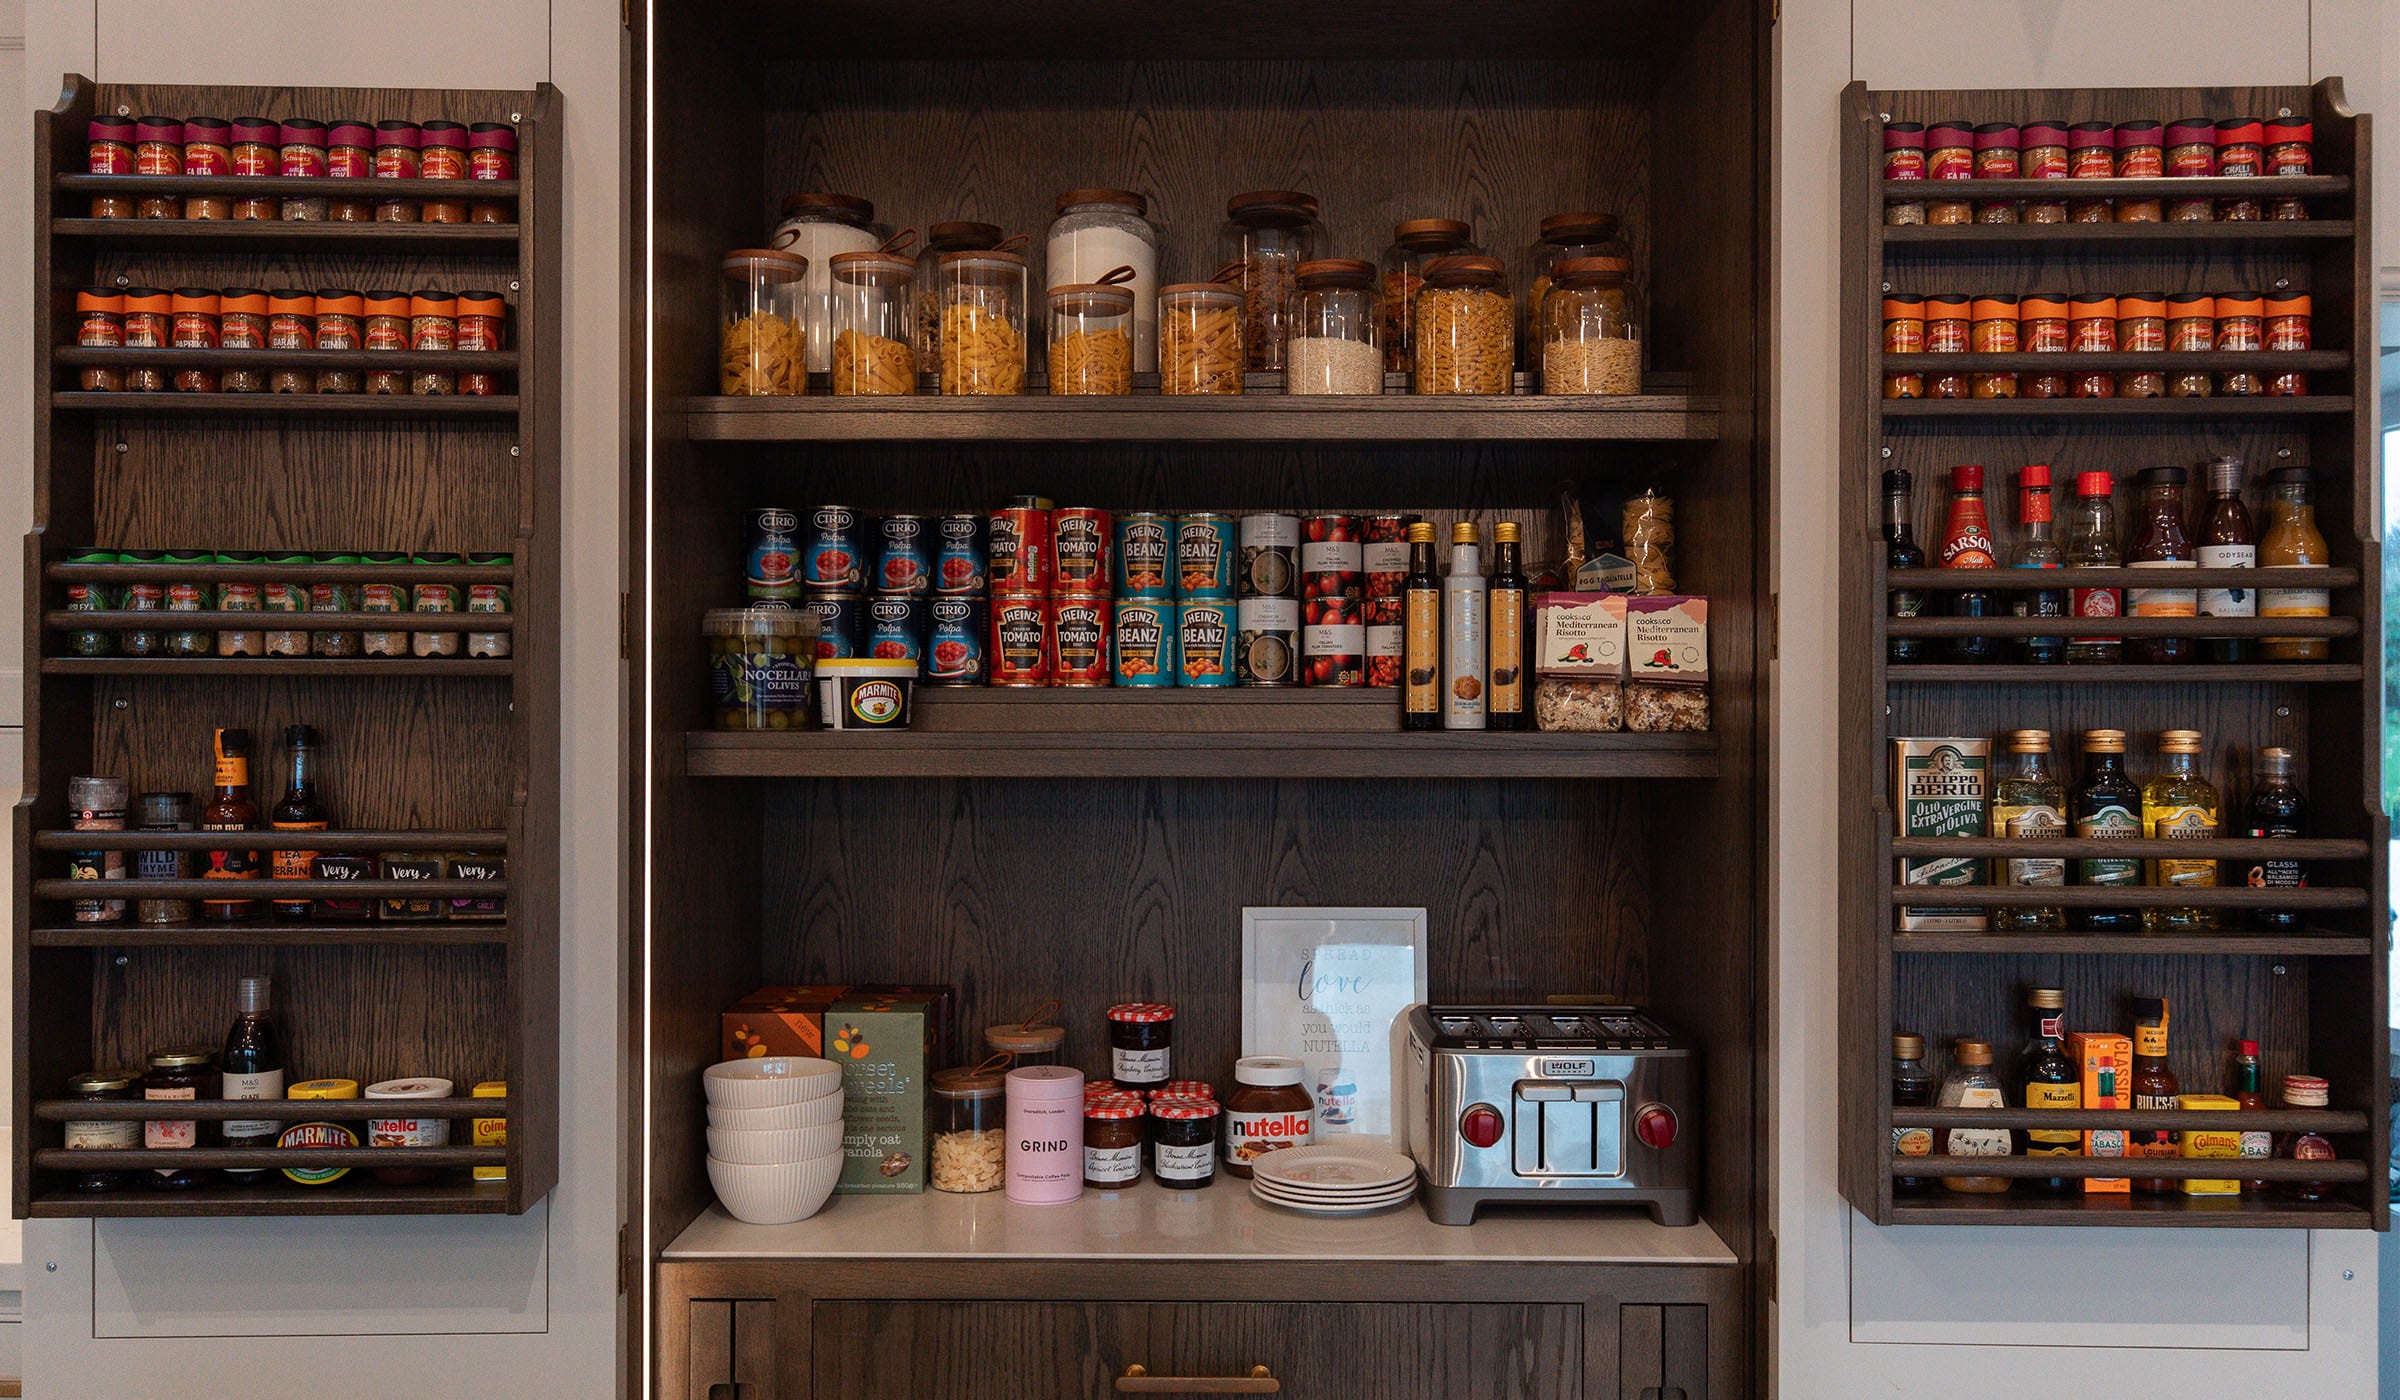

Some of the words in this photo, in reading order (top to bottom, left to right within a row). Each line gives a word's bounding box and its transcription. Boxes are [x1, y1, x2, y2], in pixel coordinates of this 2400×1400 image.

[320, 341, 348, 349] CUMIN
[2272, 342, 2305, 350] PAPRIKA
[763, 517, 794, 526] CIRIO
[817, 514, 849, 524] CIRIO
[885, 523, 916, 532] CIRIO
[943, 523, 972, 532] CIRIO
[1062, 520, 1094, 532] HEINZ
[1130, 523, 1161, 538] HEINZ
[1183, 525, 1213, 538] HEINZ
[767, 535, 790, 544] Polpa
[821, 533, 845, 542] Polpa
[888, 541, 912, 551] Polpa
[945, 541, 969, 551] Polpa
[1059, 542, 1097, 553] TOMATO
[1126, 543, 1164, 556] BEANZ
[1180, 544, 1217, 557] BEANZ
[1963, 555, 1984, 564] Malt
[132, 586, 162, 594] Schwartz
[169, 589, 199, 597] Schwartz
[365, 588, 393, 596] Schwartz
[227, 602, 256, 610] GARLIC
[419, 604, 448, 612] GARLIC
[874, 605, 905, 615] CIRIO
[936, 605, 966, 615] CIRIO
[2040, 602, 2058, 613] SOY
[1005, 609, 1038, 623] HEINZ
[1062, 608, 1095, 622] HEINZ
[1122, 611, 1153, 624] HEINZ
[1187, 611, 1219, 624] HEINZ
[877, 624, 901, 634] Polpa
[938, 624, 962, 633] Polpa
[1556, 621, 1618, 629] Mediterranean
[1636, 626, 1699, 634] Mediterranean
[1002, 632, 1041, 642] TOMATO
[1059, 632, 1098, 642] TOMATO
[1119, 628, 1157, 642] BEANZ
[1183, 628, 1223, 642] BEANZ
[1556, 629, 1586, 637] Risotto
[1637, 634, 1668, 642] Risotto
[768, 682, 799, 690] OLIVES
[858, 686, 898, 700] MARMITE
[1916, 775, 1978, 783] FILIPPO
[1910, 784, 1981, 796] BERIO
[1916, 801, 1940, 816] OLIO
[1911, 812, 1943, 828] EXTRA
[1942, 801, 1982, 819] VERGINE
[1935, 824, 1946, 837] DI
[1947, 813, 1978, 831] OLIVA
[140, 851, 175, 863] WILD
[322, 863, 350, 879] Very
[392, 866, 419, 879] Very
[458, 864, 486, 879] Very
[411, 904, 429, 912] GINGER
[1298, 960, 1374, 1001] love
[1303, 1004, 1317, 1014] as
[1319, 1003, 1352, 1014] thick
[1356, 1004, 1370, 1014] as
[794, 1019, 816, 1040] new
[1302, 1023, 1327, 1036] you
[1330, 1021, 1371, 1033] would
[1304, 1040, 1370, 1052] NUTELLA
[845, 1062, 896, 1077] orset
[2114, 1041, 2129, 1101] CLASSIC
[846, 1078, 905, 1095] ereals
[371, 1119, 418, 1132] nutella
[1233, 1112, 1309, 1136] nutella
[285, 1127, 347, 1148] MARMITE
[844, 1134, 876, 1147] mply
[880, 1134, 901, 1145] oat
[1021, 1140, 1068, 1152] GRIND
[2193, 1135, 2238, 1152] Colman's
[844, 1147, 884, 1157] ranola
